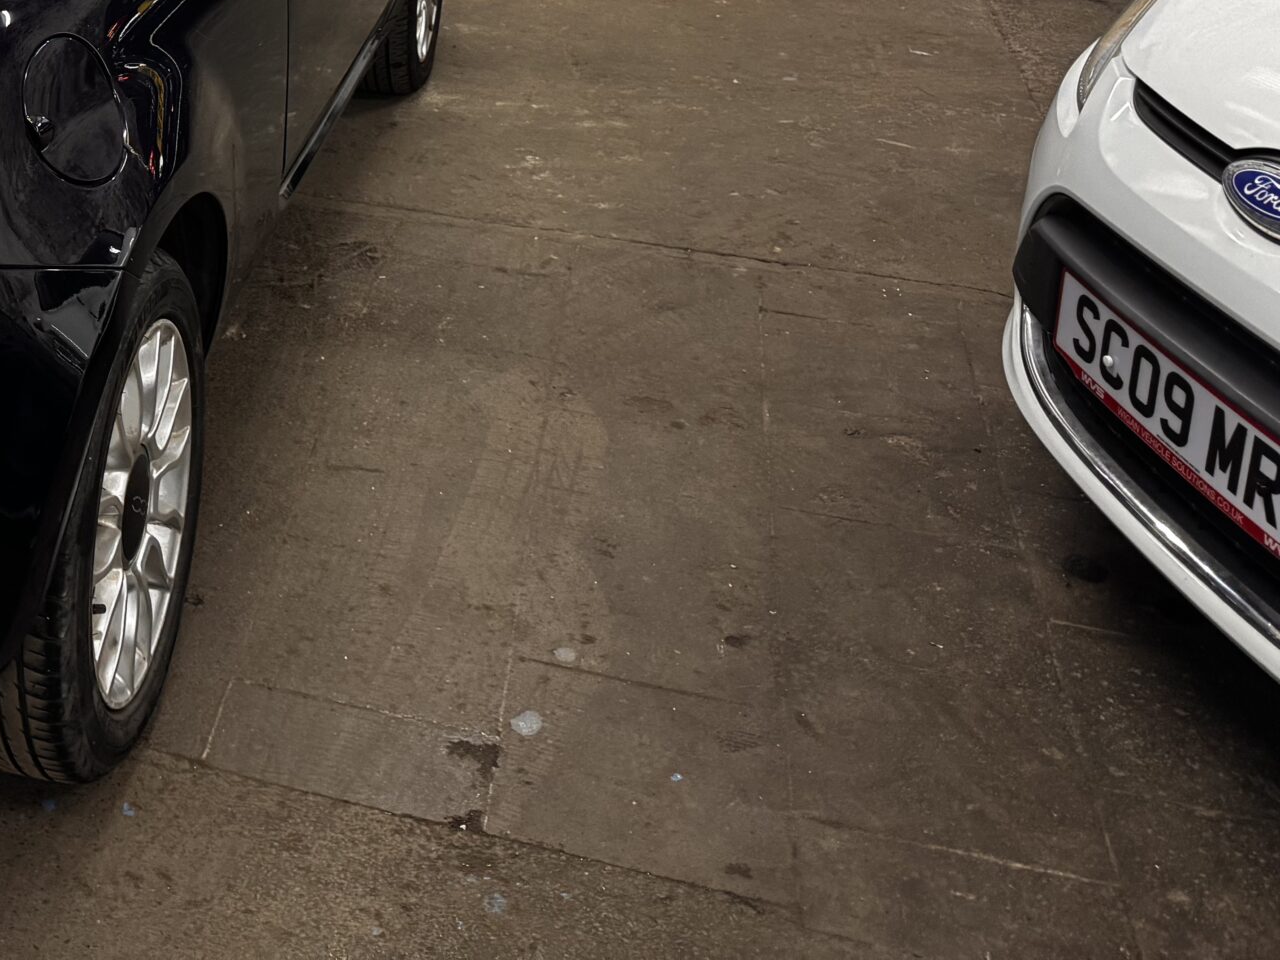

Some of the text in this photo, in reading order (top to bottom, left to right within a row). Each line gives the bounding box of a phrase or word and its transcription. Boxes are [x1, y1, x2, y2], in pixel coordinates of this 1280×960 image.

[1072, 293, 1280, 531] SC09 MR
[1081, 370, 1106, 400] WVS
[1140, 427, 1172, 462] VEHICLE
[1172, 458, 1217, 501] SOLUTIONS
